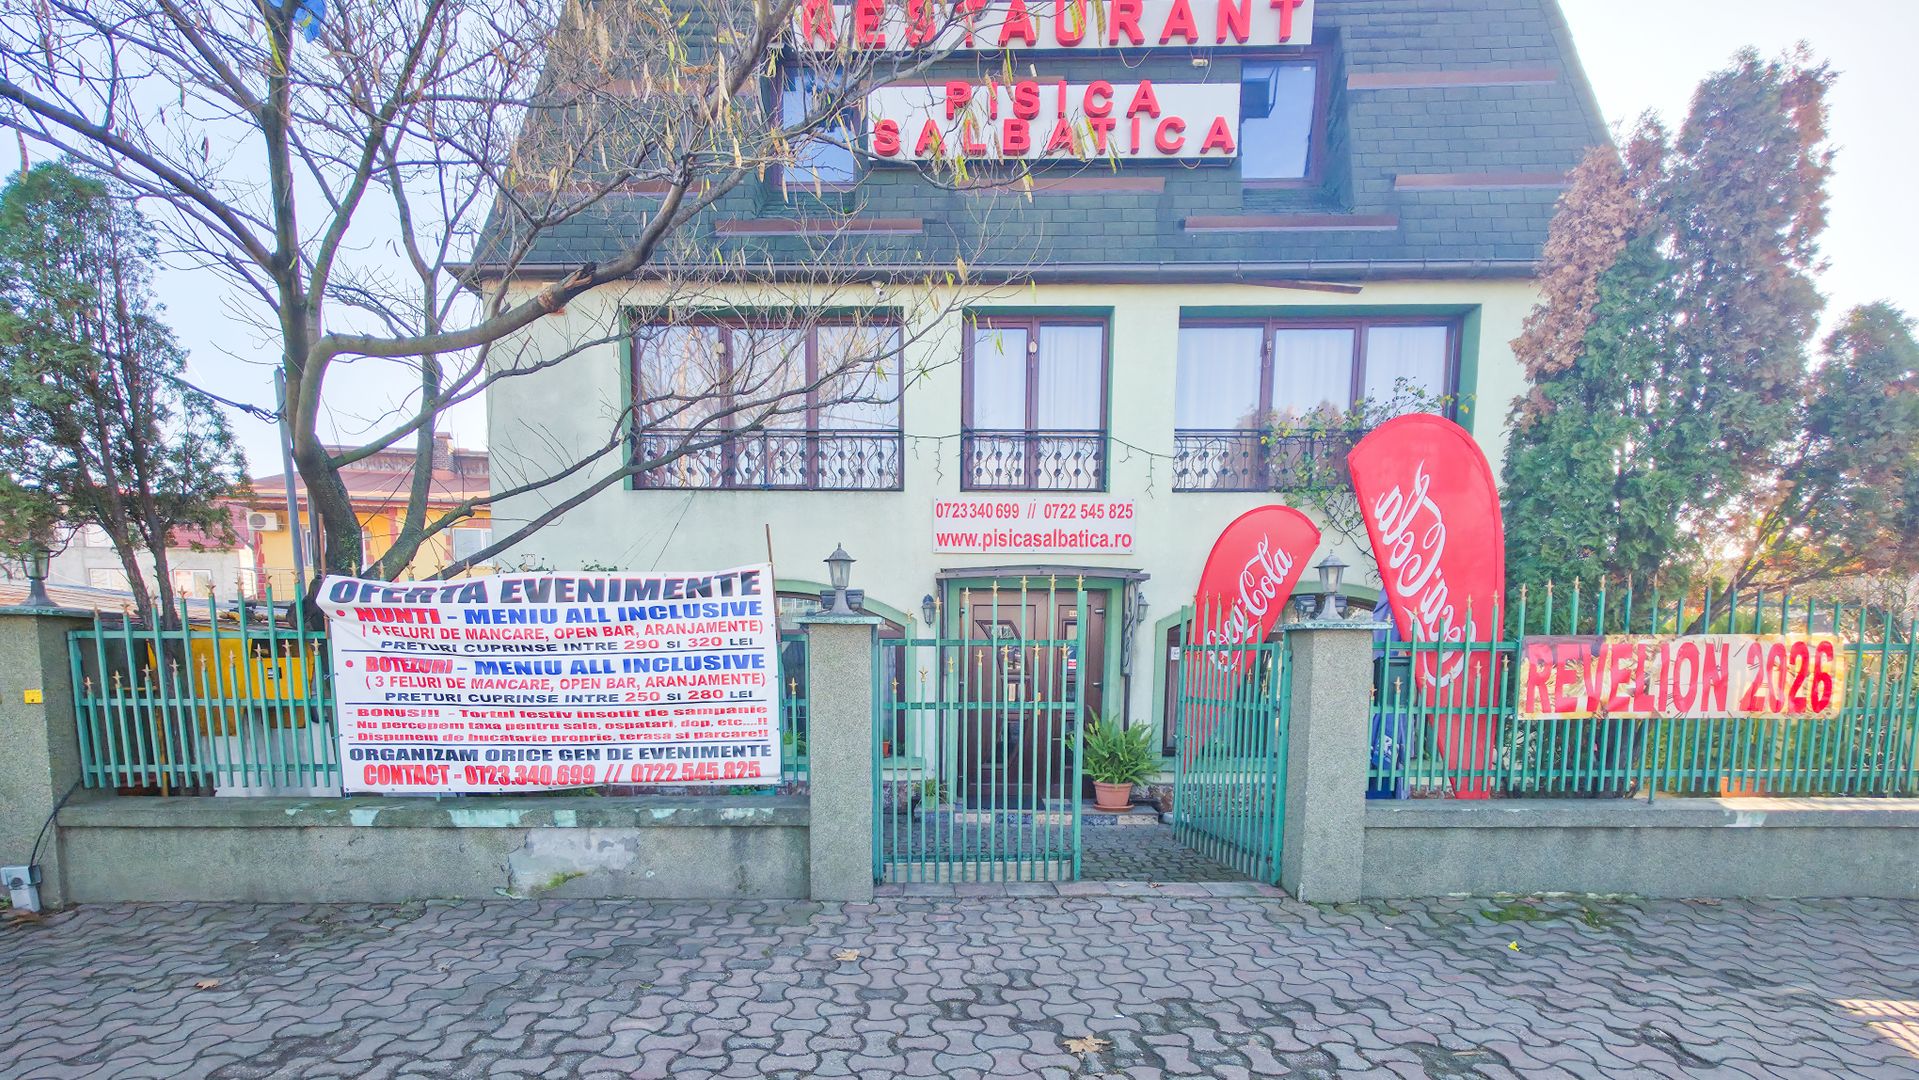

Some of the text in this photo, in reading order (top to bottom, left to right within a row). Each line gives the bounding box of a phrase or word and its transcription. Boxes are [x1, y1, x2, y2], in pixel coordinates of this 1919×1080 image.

[801, 0, 1302, 47] RESTAURANT
[946, 79, 1163, 120] PISICA
[873, 116, 1237, 157] SALBATICA
[935, 502, 967, 519] 0723
[969, 502, 993, 519] 340
[995, 502, 1020, 519] 699
[1044, 503, 1076, 519] 0722
[1080, 503, 1105, 519] 545
[1109, 503, 1133, 519] 825
[936, 529, 1132, 551] www.pisicasalbatica.ro
[329, 570, 761, 603] OFERTA EVENIMENTE
[354, 608, 441, 624] NUNTI
[464, 608, 558, 625] MENIU
[565, 608, 612, 624] ALL
[618, 601, 763, 621] INCLUSIVE
[386, 625, 435, 639] FELURI
[440, 627, 460, 640] DE
[465, 628, 550, 642] MANCARE,
[554, 627, 597, 640] OPEN
[603, 625, 640, 639] BAR,
[644, 620, 764, 636] ARANJAMENTE)
[381, 637, 753, 653] PRETURI CUPRINSE INTRE 290 SI 320 LEI
[365, 656, 453, 674] BOTEZURI
[475, 660, 562, 675] MENIU
[570, 659, 616, 675] ALL
[623, 654, 766, 674] INCLUSIVE
[389, 676, 441, 689] FELURI
[446, 678, 466, 689] DE
[471, 679, 554, 692] MANCARE,
[559, 678, 604, 690] OPEN
[606, 677, 641, 690] BAR,
[645, 673, 766, 688] ARANJAMENTE)
[1525, 641, 1835, 714] REVELION 2026
[385, 690, 752, 703] PRETURI CUPRINSE INTRE 250 SI 280 LEI
[357, 708, 440, 718] BONUS!!!
[459, 709, 515, 719] Tortul
[519, 710, 572, 719] festiv
[577, 709, 640, 719] insotit
[644, 708, 669, 718] de
[673, 706, 768, 716] sampanie
[356, 721, 377, 729] Nu
[381, 721, 464, 730] percepem
[468, 721, 501, 730] taxa
[505, 721, 560, 730] pentru
[563, 722, 601, 731] sala,
[605, 720, 676, 730] ospatari,
[357, 733, 438, 742] Dispunem
[442, 733, 464, 742] de
[468, 733, 547, 742] bucatarie
[551, 733, 617, 743] proprie,
[620, 731, 671, 741] terasa
[675, 731, 690, 740] si
[693, 729, 768, 740] parcare!!
[349, 745, 772, 762] ORGANIZAM ORICE GEN DE EVENIMENTE
[364, 764, 450, 785] CONTACT
[464, 764, 596, 786] 0723.340.699
[631, 761, 761, 784] 0722.545.825
